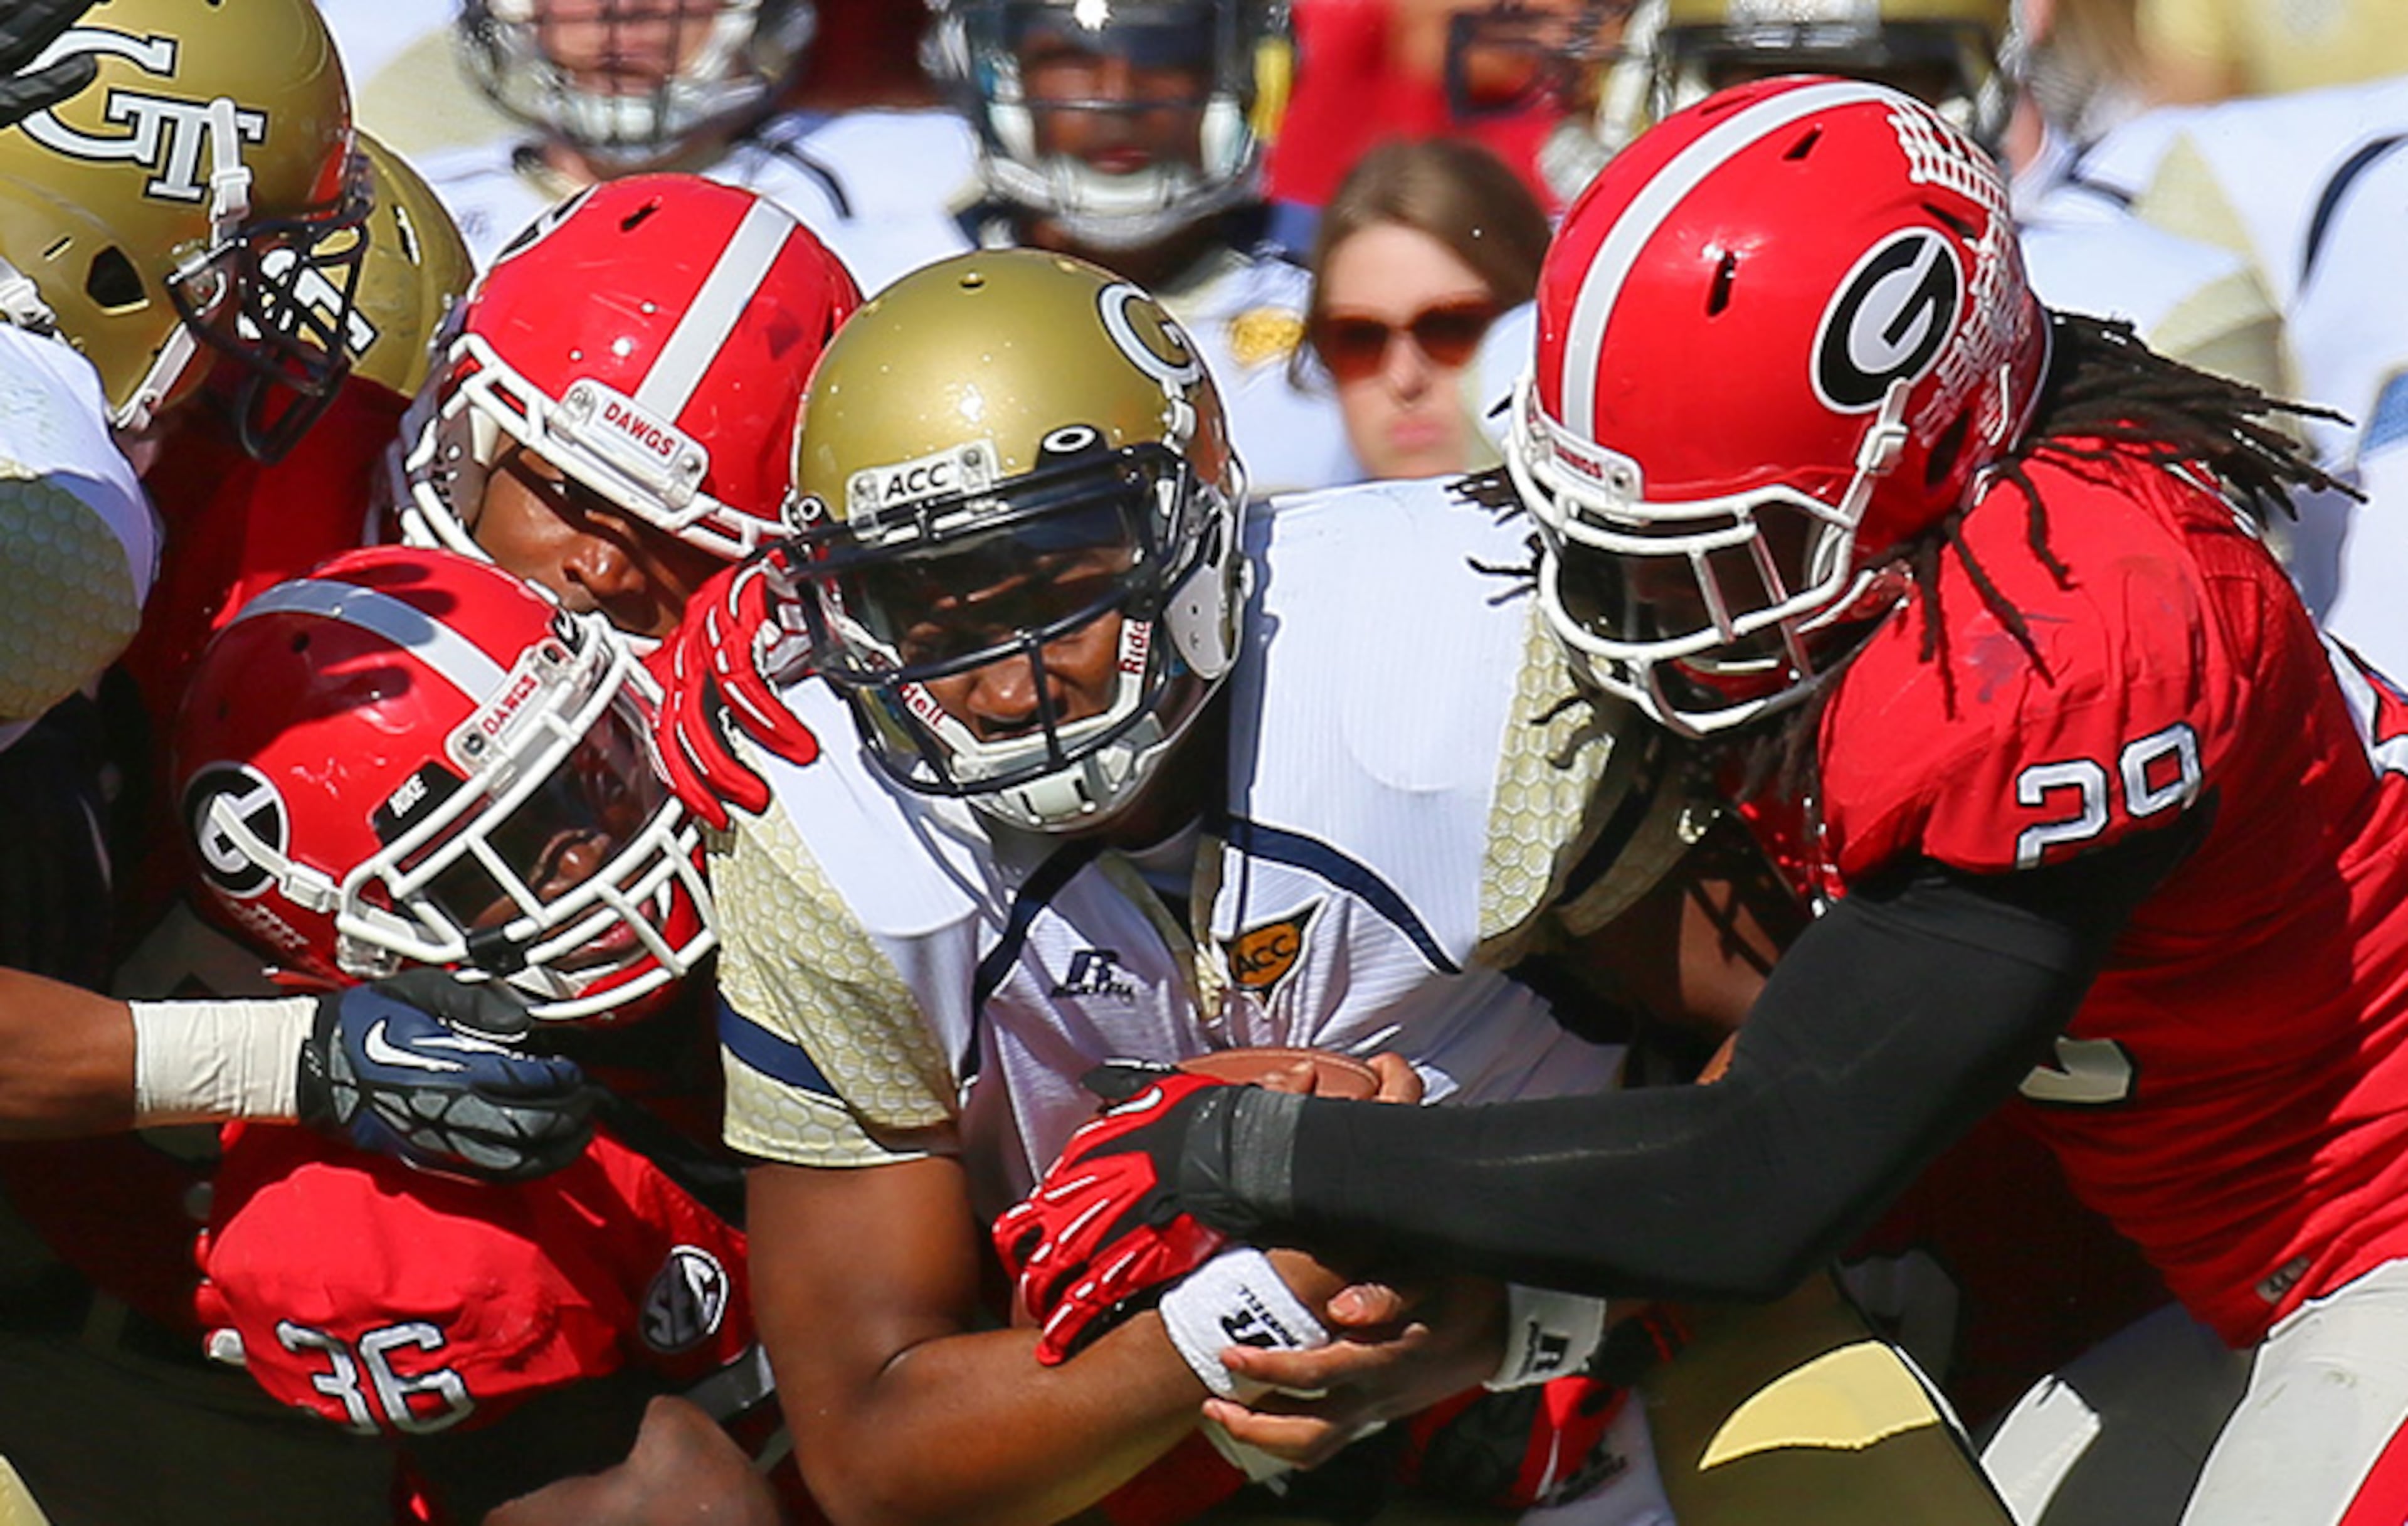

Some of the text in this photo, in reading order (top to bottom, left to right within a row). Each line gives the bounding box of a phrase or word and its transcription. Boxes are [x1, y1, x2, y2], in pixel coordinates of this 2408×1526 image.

[13, 27, 268, 202] GT
[604, 400, 675, 456] DAWGS
[884, 461, 948, 501] ACC
[1237, 933, 1297, 972] ACC
[276, 1320, 475, 1436] 36
